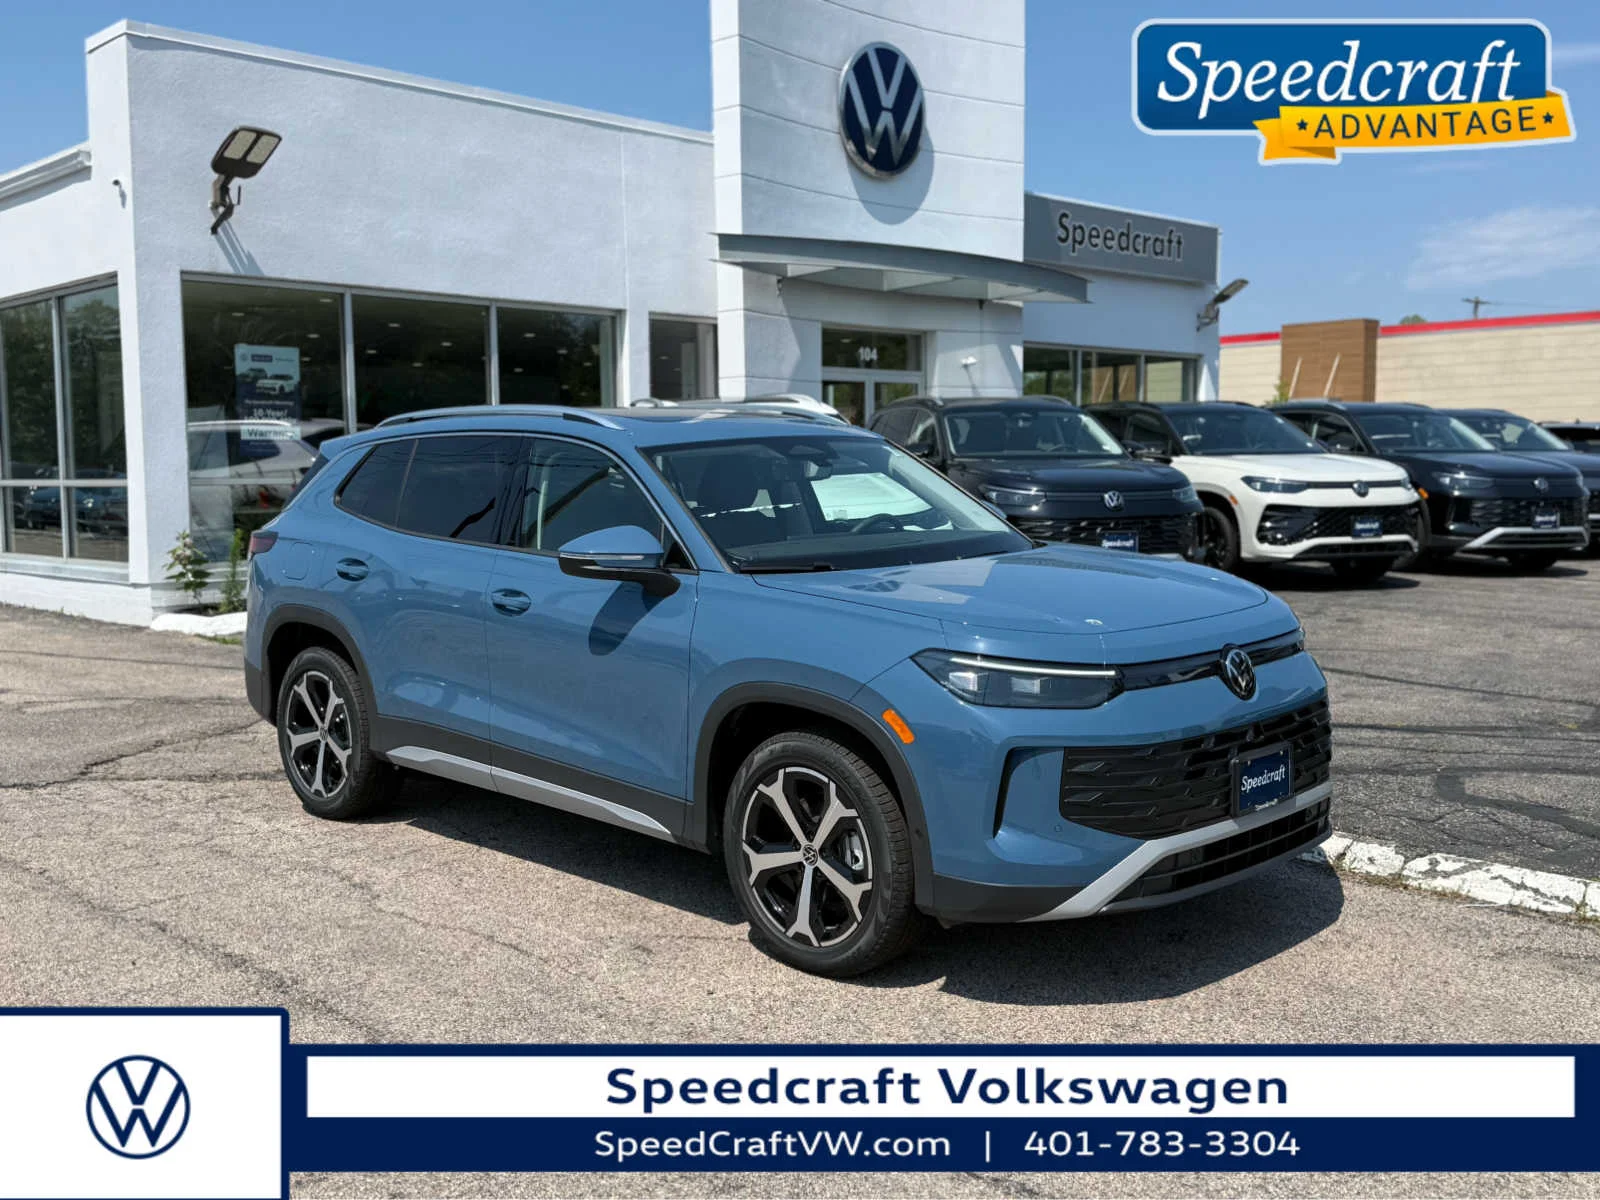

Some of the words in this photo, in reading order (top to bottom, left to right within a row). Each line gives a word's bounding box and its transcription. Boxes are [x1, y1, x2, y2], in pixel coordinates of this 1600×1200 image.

[1056, 210, 1184, 260] Speedcraft
[858, 346, 878, 361] 104
[1240, 763, 1286, 793] Speedcraft
